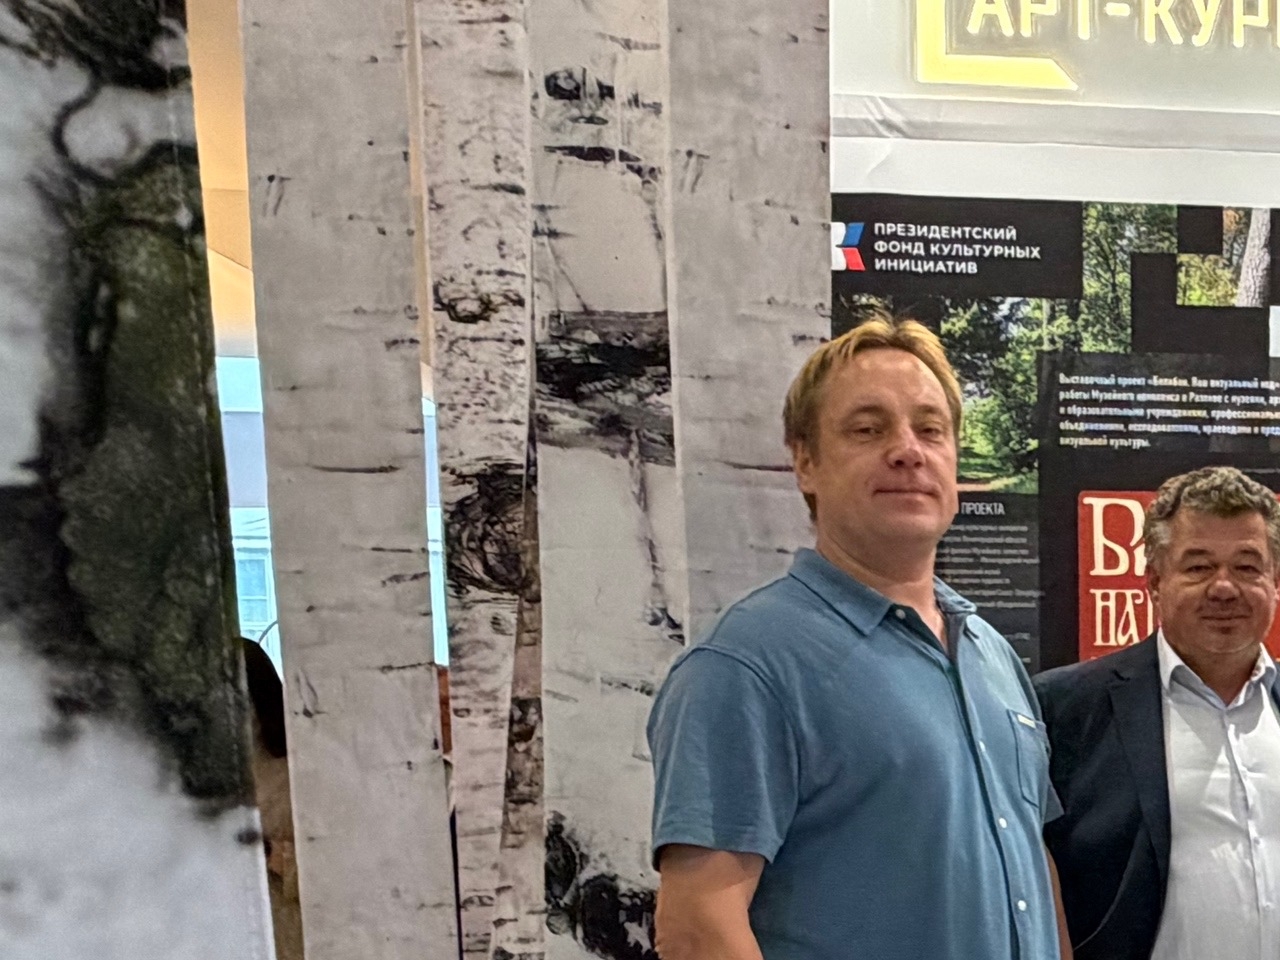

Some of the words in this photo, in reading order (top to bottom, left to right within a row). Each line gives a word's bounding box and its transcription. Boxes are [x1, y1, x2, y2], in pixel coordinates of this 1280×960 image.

[873, 222, 1017, 241] ПРЕЗИДЕНТСКИЙ
[873, 241, 925, 256] ФОНД
[929, 243, 1042, 260] КУЛЬТУРНЫХ
[874, 258, 978, 274] ИНИЦИАТИВ
[961, 502, 1006, 516] ПРОЕКТА
[1089, 588, 1154, 646] НА
